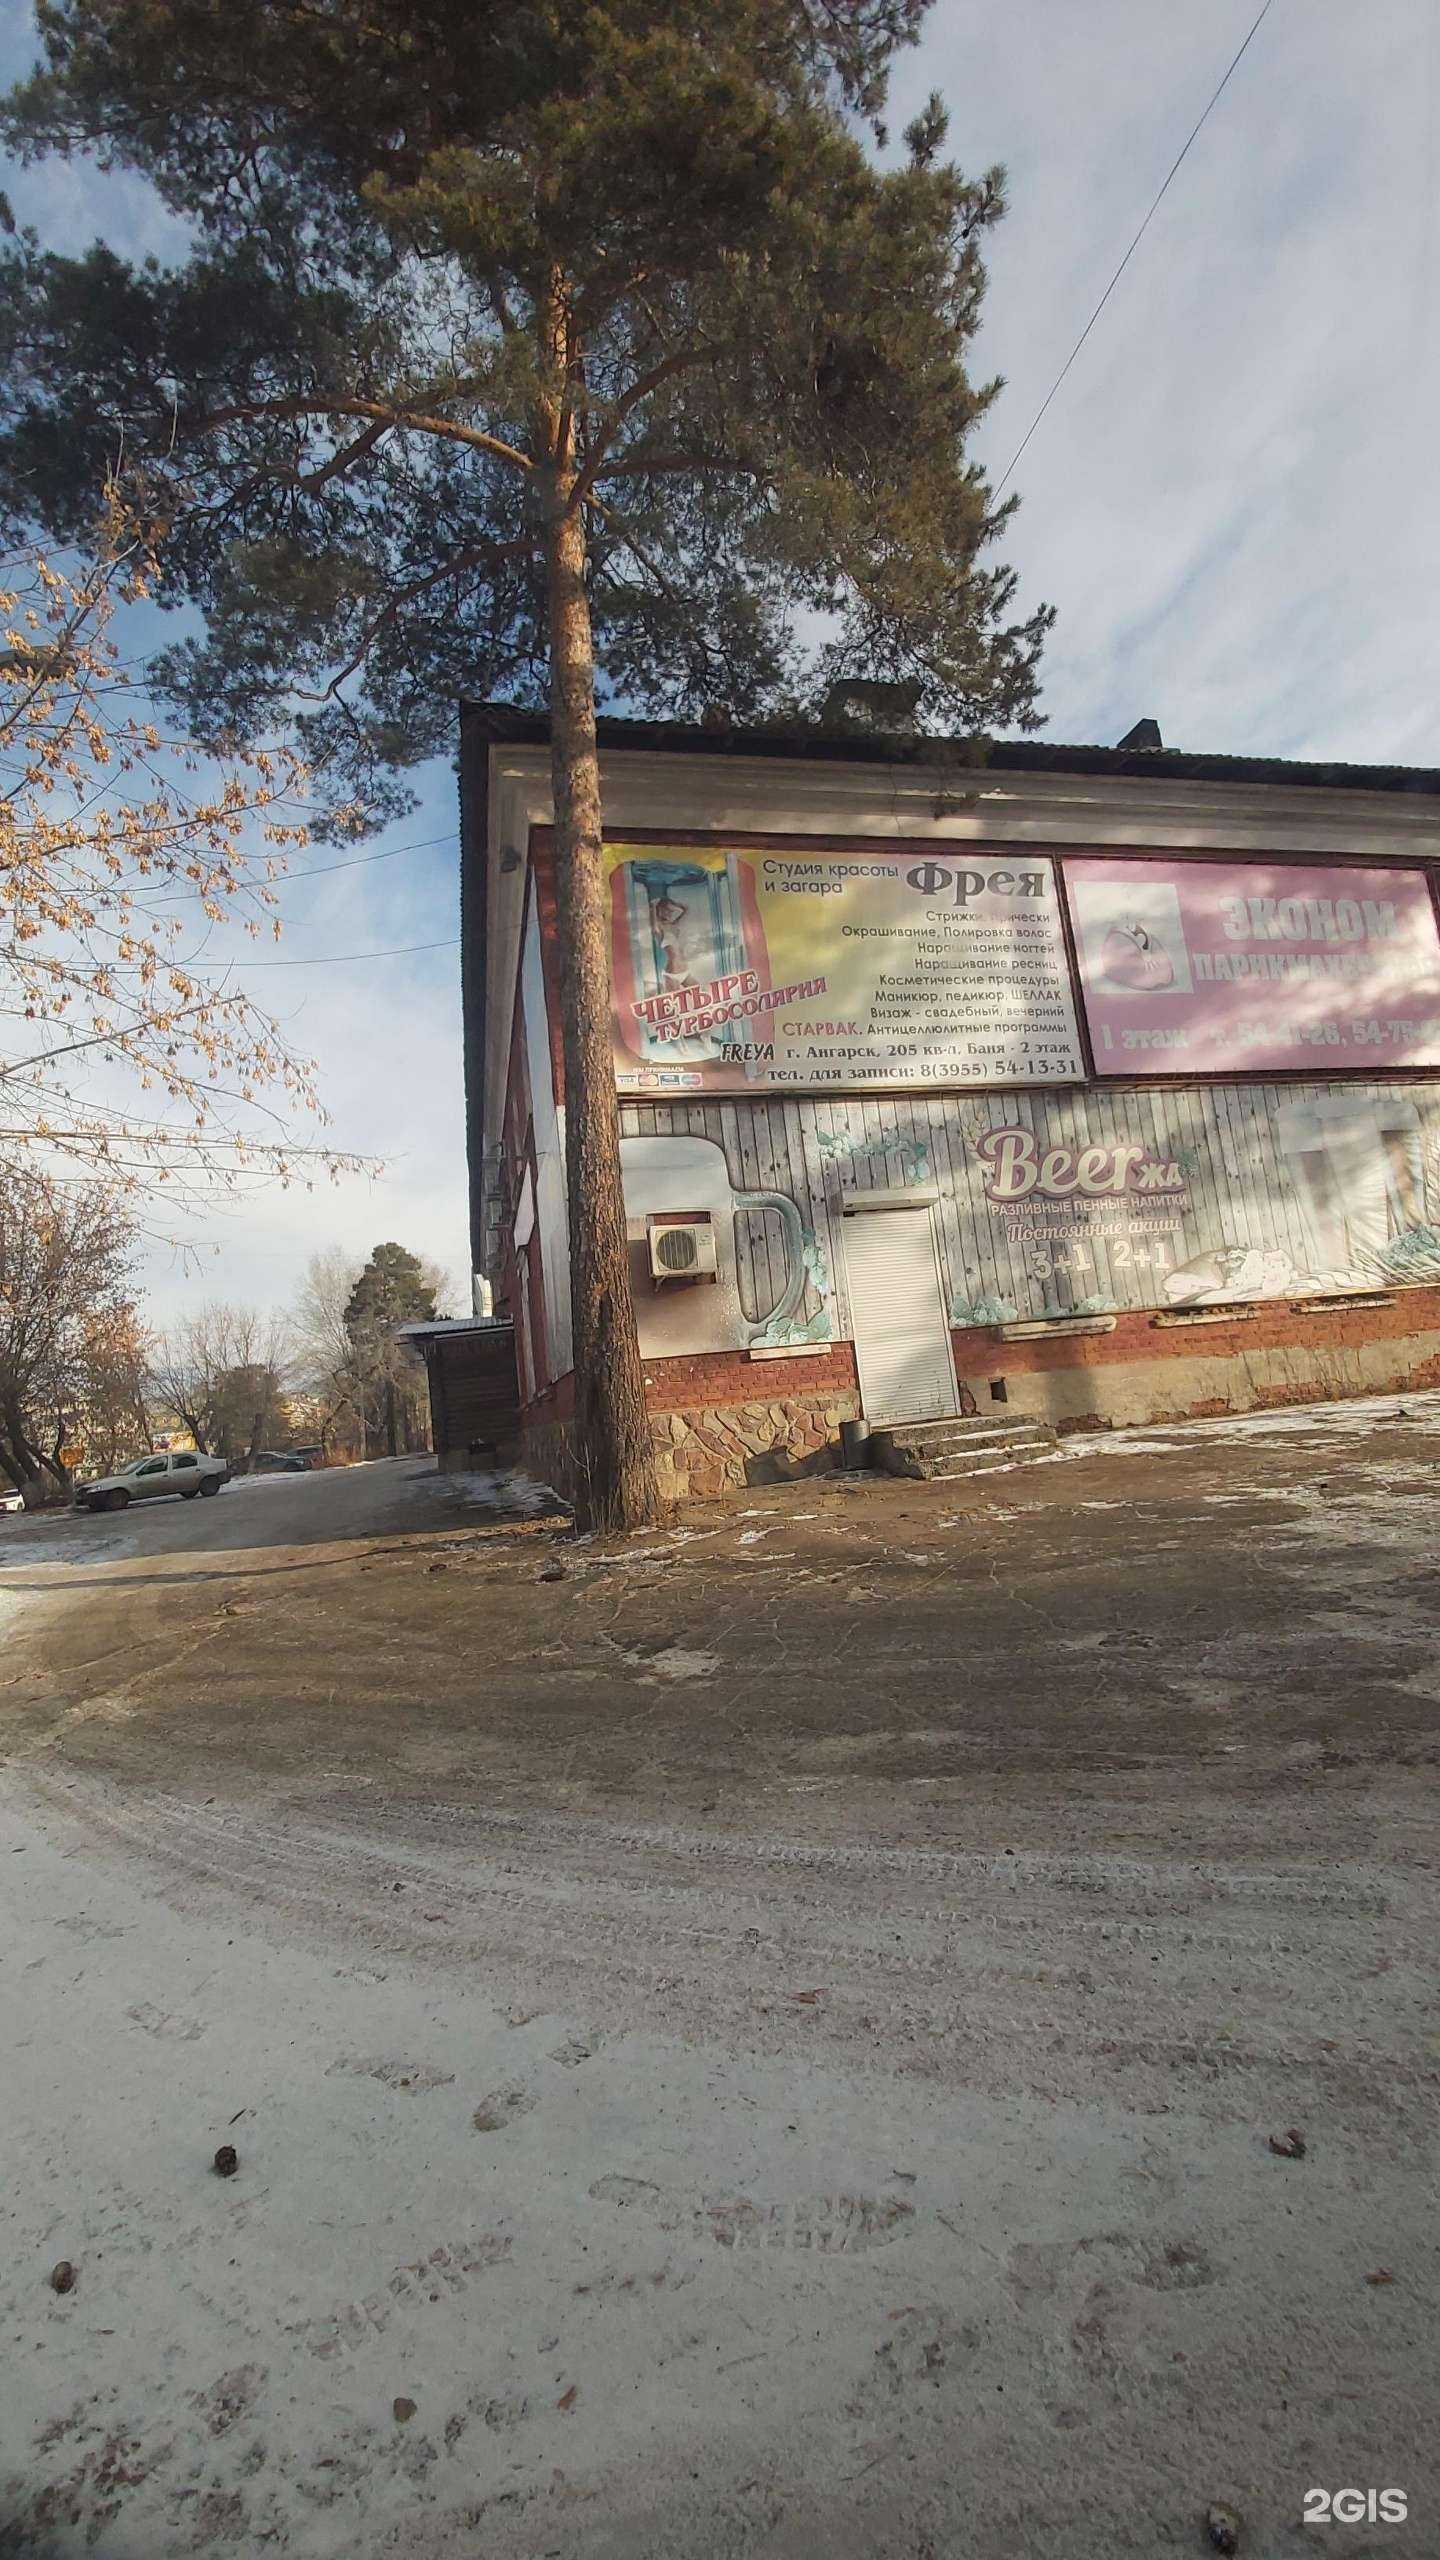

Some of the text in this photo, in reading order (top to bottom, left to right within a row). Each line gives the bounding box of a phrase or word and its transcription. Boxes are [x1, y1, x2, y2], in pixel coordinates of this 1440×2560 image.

[763, 860, 899, 881] Студия красоты
[765, 881, 843, 897] и загара
[906, 862, 1047, 906] Фрея
[926, 911, 983, 925] Стрижк
[1220, 897, 1397, 941] ЭКОНОМ
[842, 925, 1051, 939] Окрашивание, Полировка волос
[918, 942, 1055, 956] Нараивание ногтей
[1011, 960, 1058, 972] ресниц
[879, 974, 1059, 987] Косметические процедуры
[633, 970, 759, 1024] ЧЕТЫРЕ
[875, 990, 942, 1003] Маникюр,
[1011, 990, 1062, 1001] ШЕЛЛАК
[870, 1007, 911, 1018] Визаж
[1006, 1006, 1064, 1019] вечерний
[867, 1023, 991, 1036] Антицеллюлитные
[994, 1023, 1067, 1036] программы
[721, 1043, 774, 1062] FREYA
[786, 1048, 800, 1058] г.
[806, 1046, 880, 1060] Ангарск,
[886, 1044, 917, 1057] 205
[967, 1042, 1005, 1055] Баня
[1020, 1042, 1030, 1053] 2
[1034, 1043, 1071, 1054] этаж
[768, 1060, 1078, 1082] тел. для записи: 8(3955) 54-13-31
[991, 1194, 1188, 1216] РАЗЛИВНЫЕ ПЕННЫЕ НАПИТКИ
[1008, 1219, 1182, 1242] Постоянные акции
[1031, 1241, 1170, 1279] 3+1 2+1
